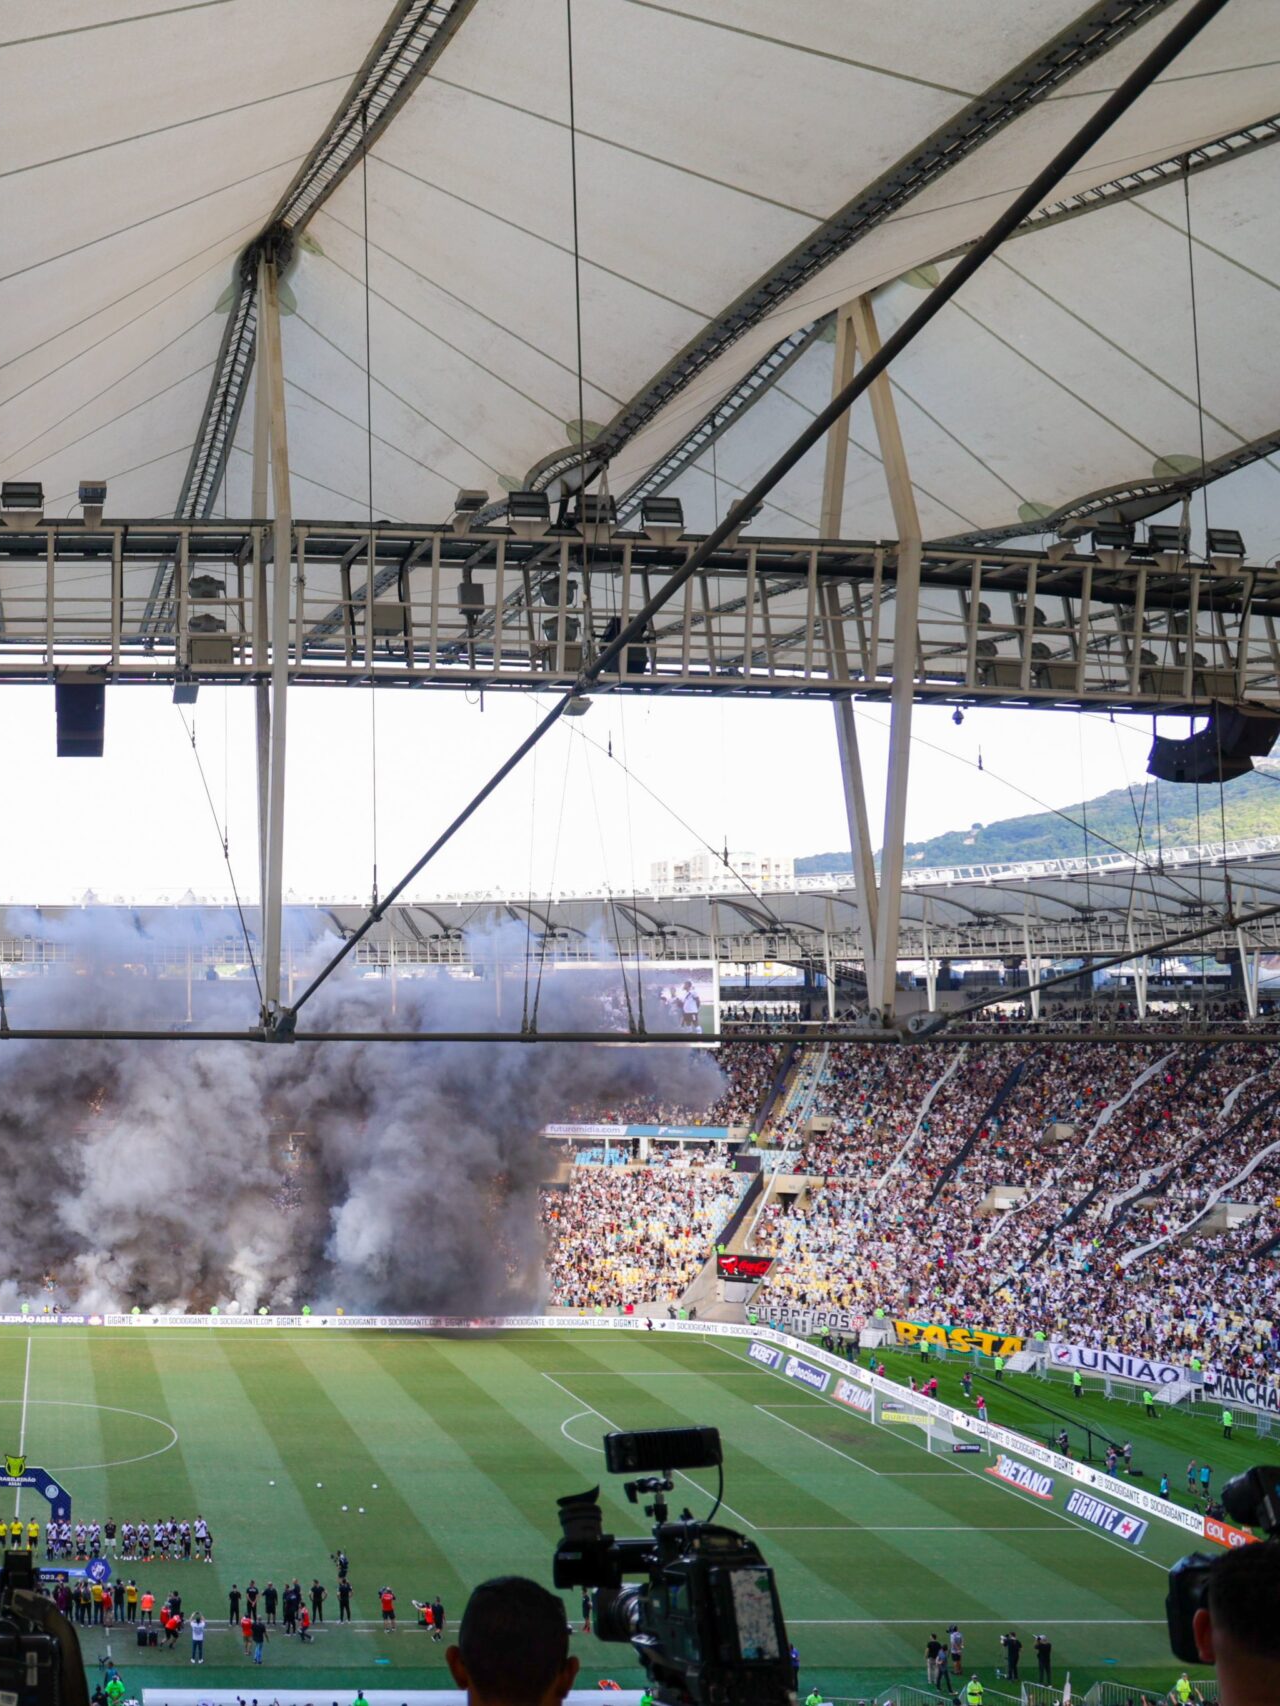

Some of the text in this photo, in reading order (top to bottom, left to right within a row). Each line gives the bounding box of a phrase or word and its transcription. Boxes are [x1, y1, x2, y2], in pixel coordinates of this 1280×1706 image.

[107, 1316, 133, 1325] GIGANTE
[276, 1317, 302, 1327] GIGANTE
[613, 1318, 639, 1329] GIGANTE
[895, 1321, 1024, 1358] RASTA
[1208, 1375, 1280, 1411] MANCHA
[1000, 1459, 1051, 1496] BETANO
[1010, 1435, 1052, 1464] SOCIOGIGANTE.COM
[1104, 1478, 1140, 1507] SOCIOGIGANTE
[1149, 1499, 1203, 1532] SOCIOGIGANTE.COM
[1066, 1492, 1119, 1532] GIGANTE
[1206, 1522, 1226, 1542] GOL
